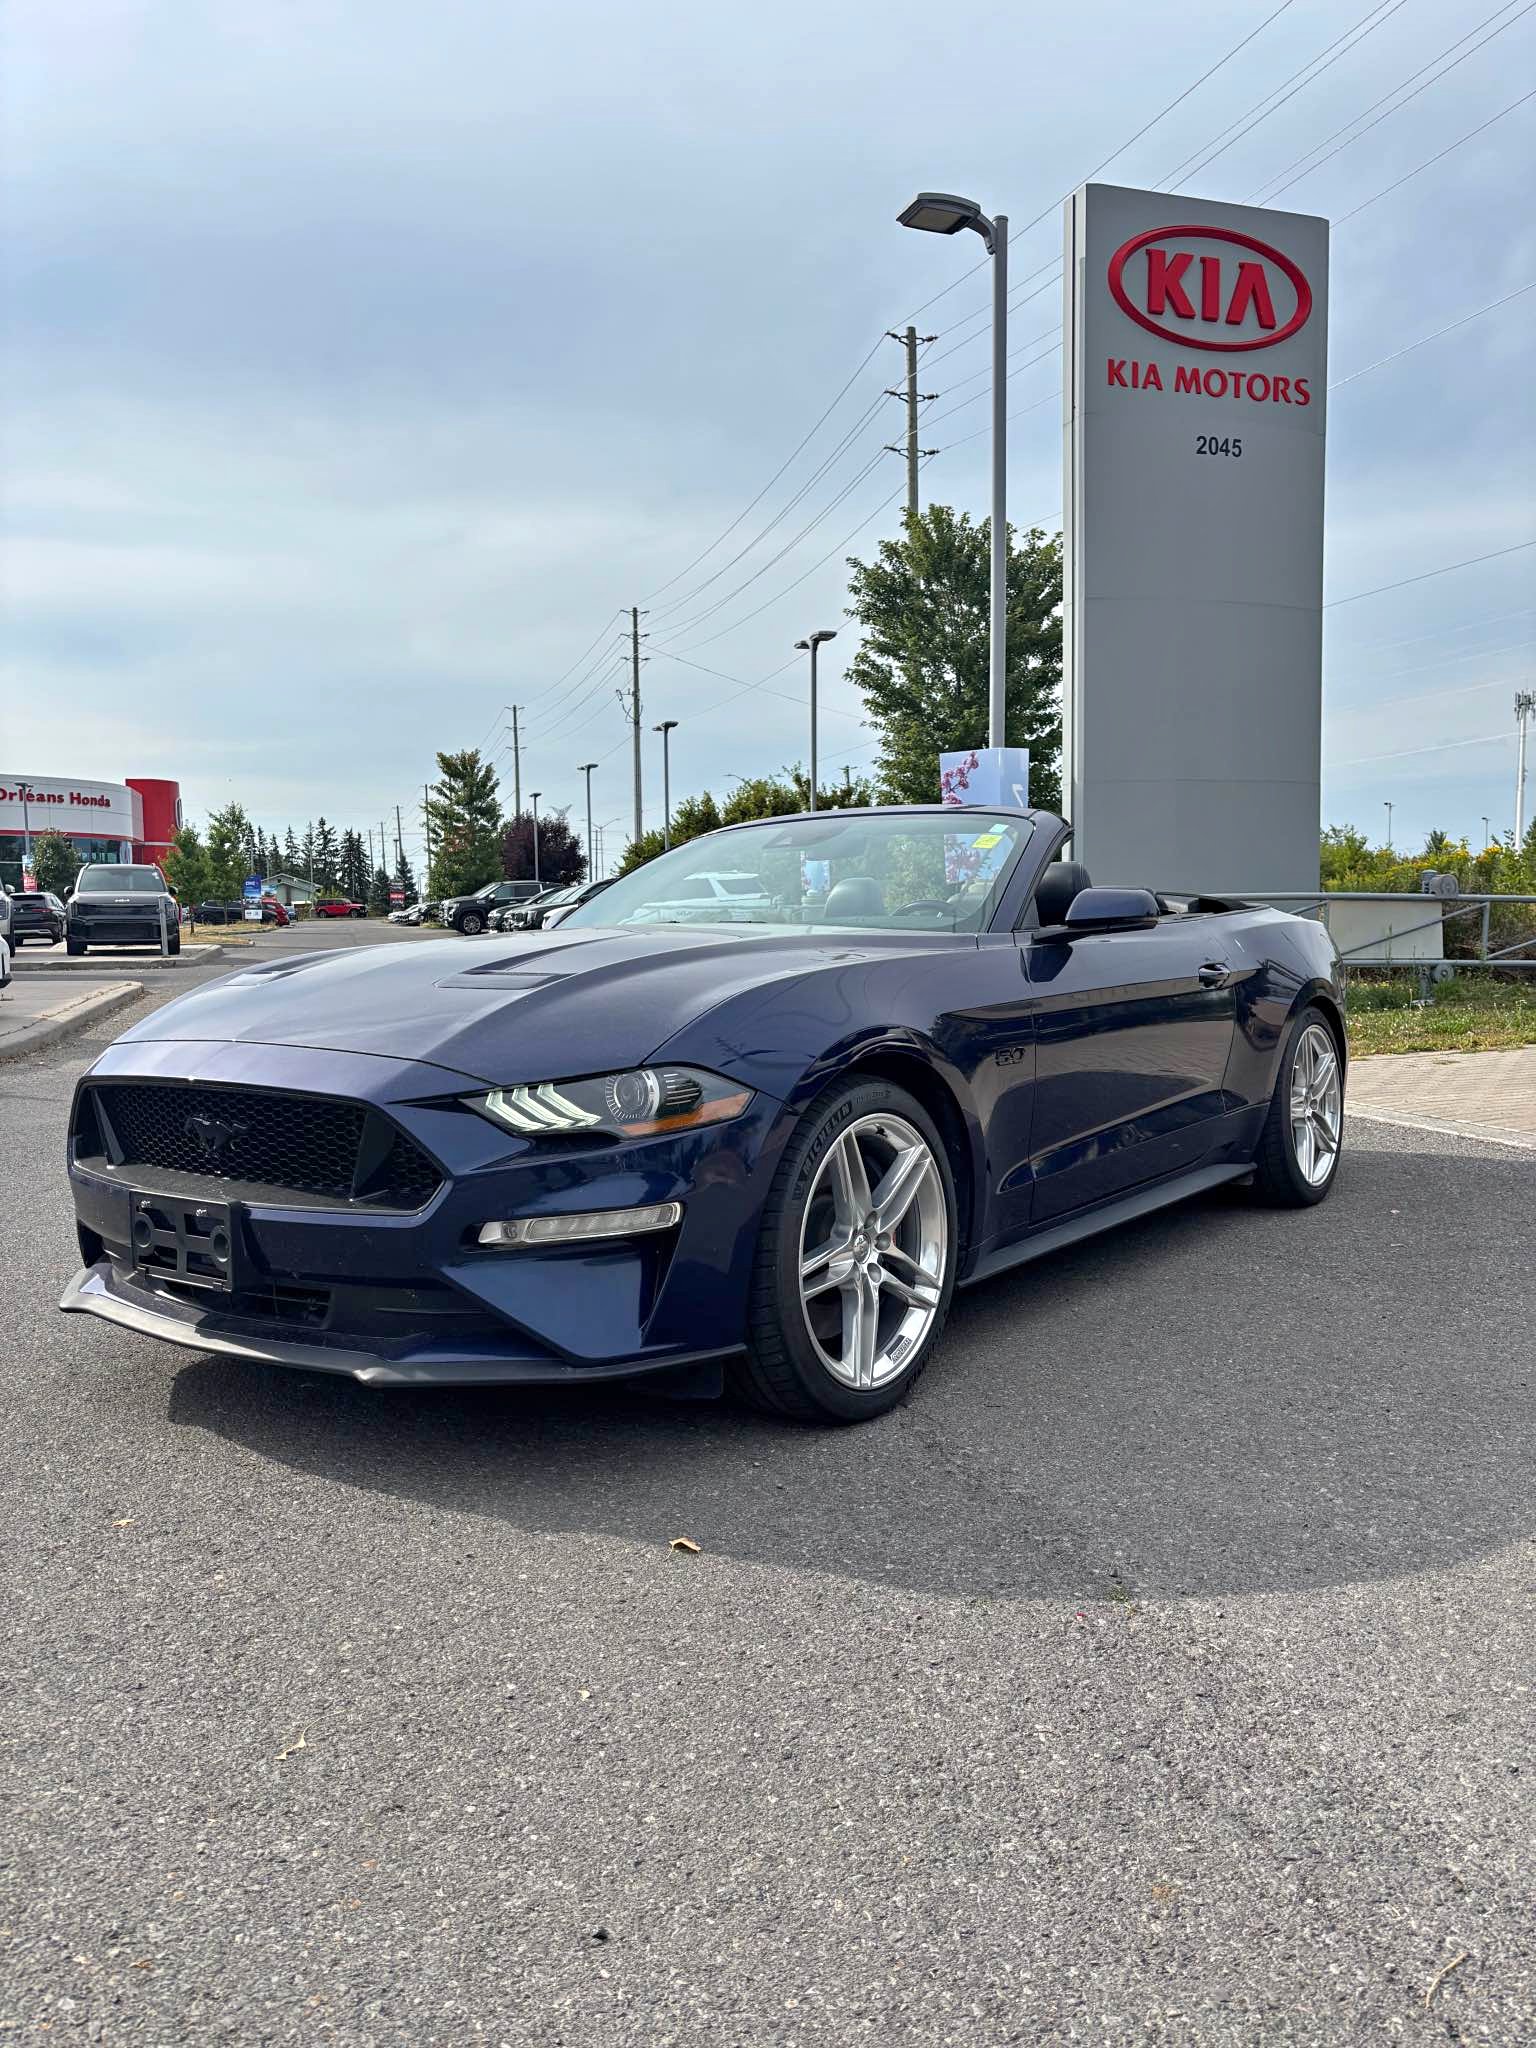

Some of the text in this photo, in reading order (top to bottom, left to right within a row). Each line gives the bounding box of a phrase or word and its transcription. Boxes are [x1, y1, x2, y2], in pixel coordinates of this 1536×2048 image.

[1145, 248, 1277, 330] KIA
[1107, 358, 1312, 406] KIA MOTORS
[1196, 435, 1243, 457] 2045
[69, 792, 111, 807] Honda
[803, 1102, 852, 1175] MICHELIN
